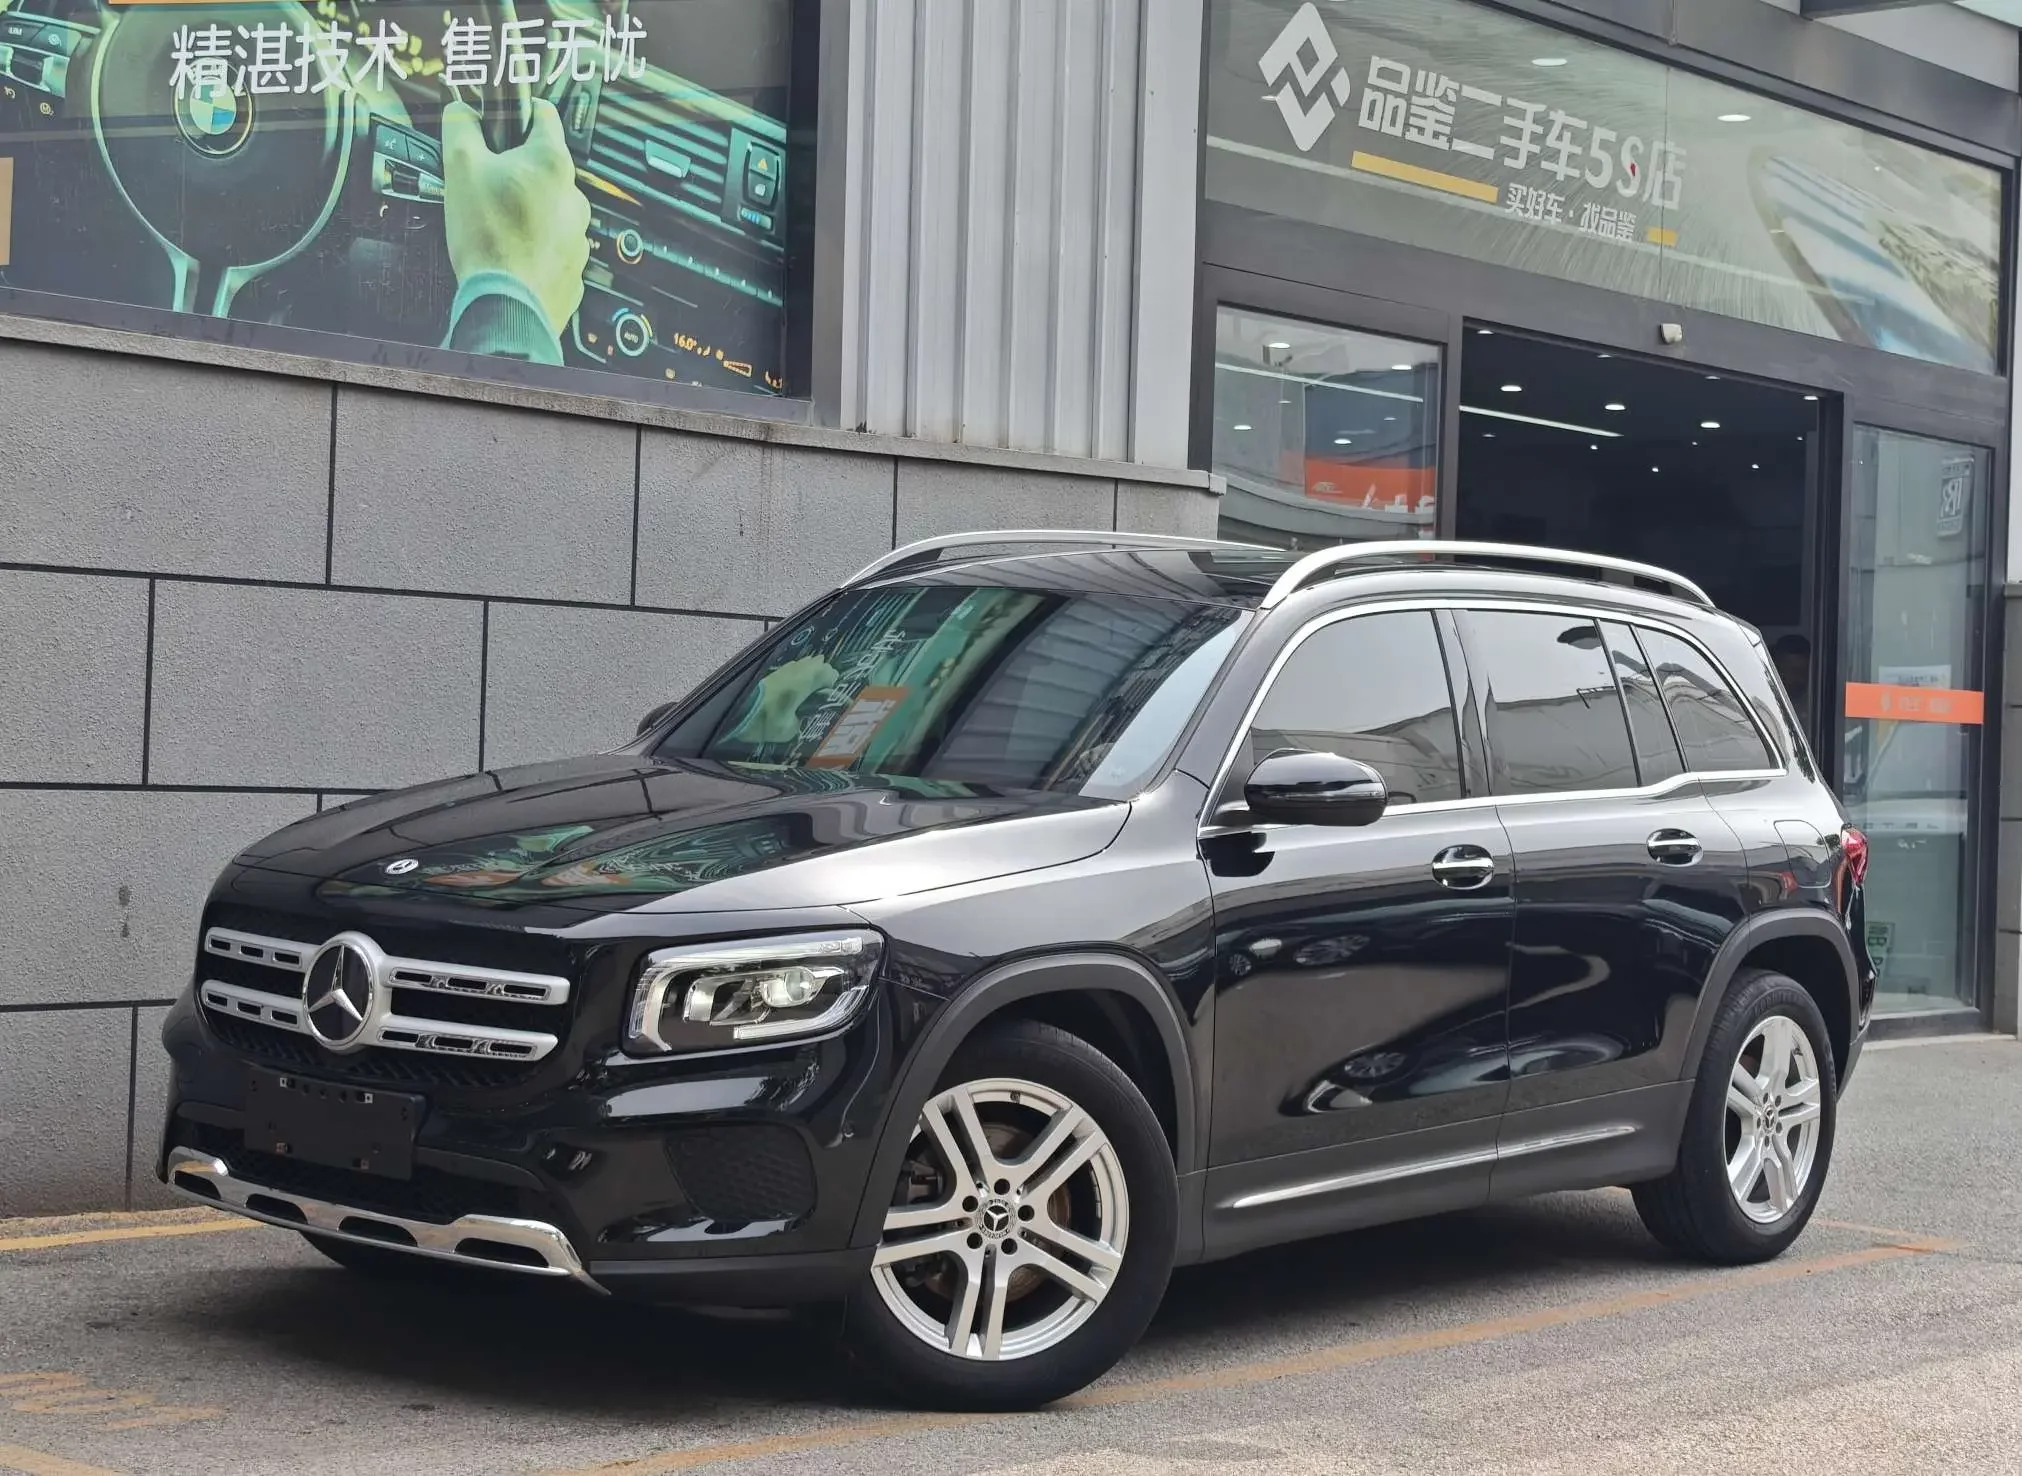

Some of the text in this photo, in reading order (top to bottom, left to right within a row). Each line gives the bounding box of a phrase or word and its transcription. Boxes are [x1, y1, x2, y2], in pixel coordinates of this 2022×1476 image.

[169, 13, 647, 100] 精湛技术 售后无忧
[1358, 55, 1687, 210] 品鉴二手车5S店
